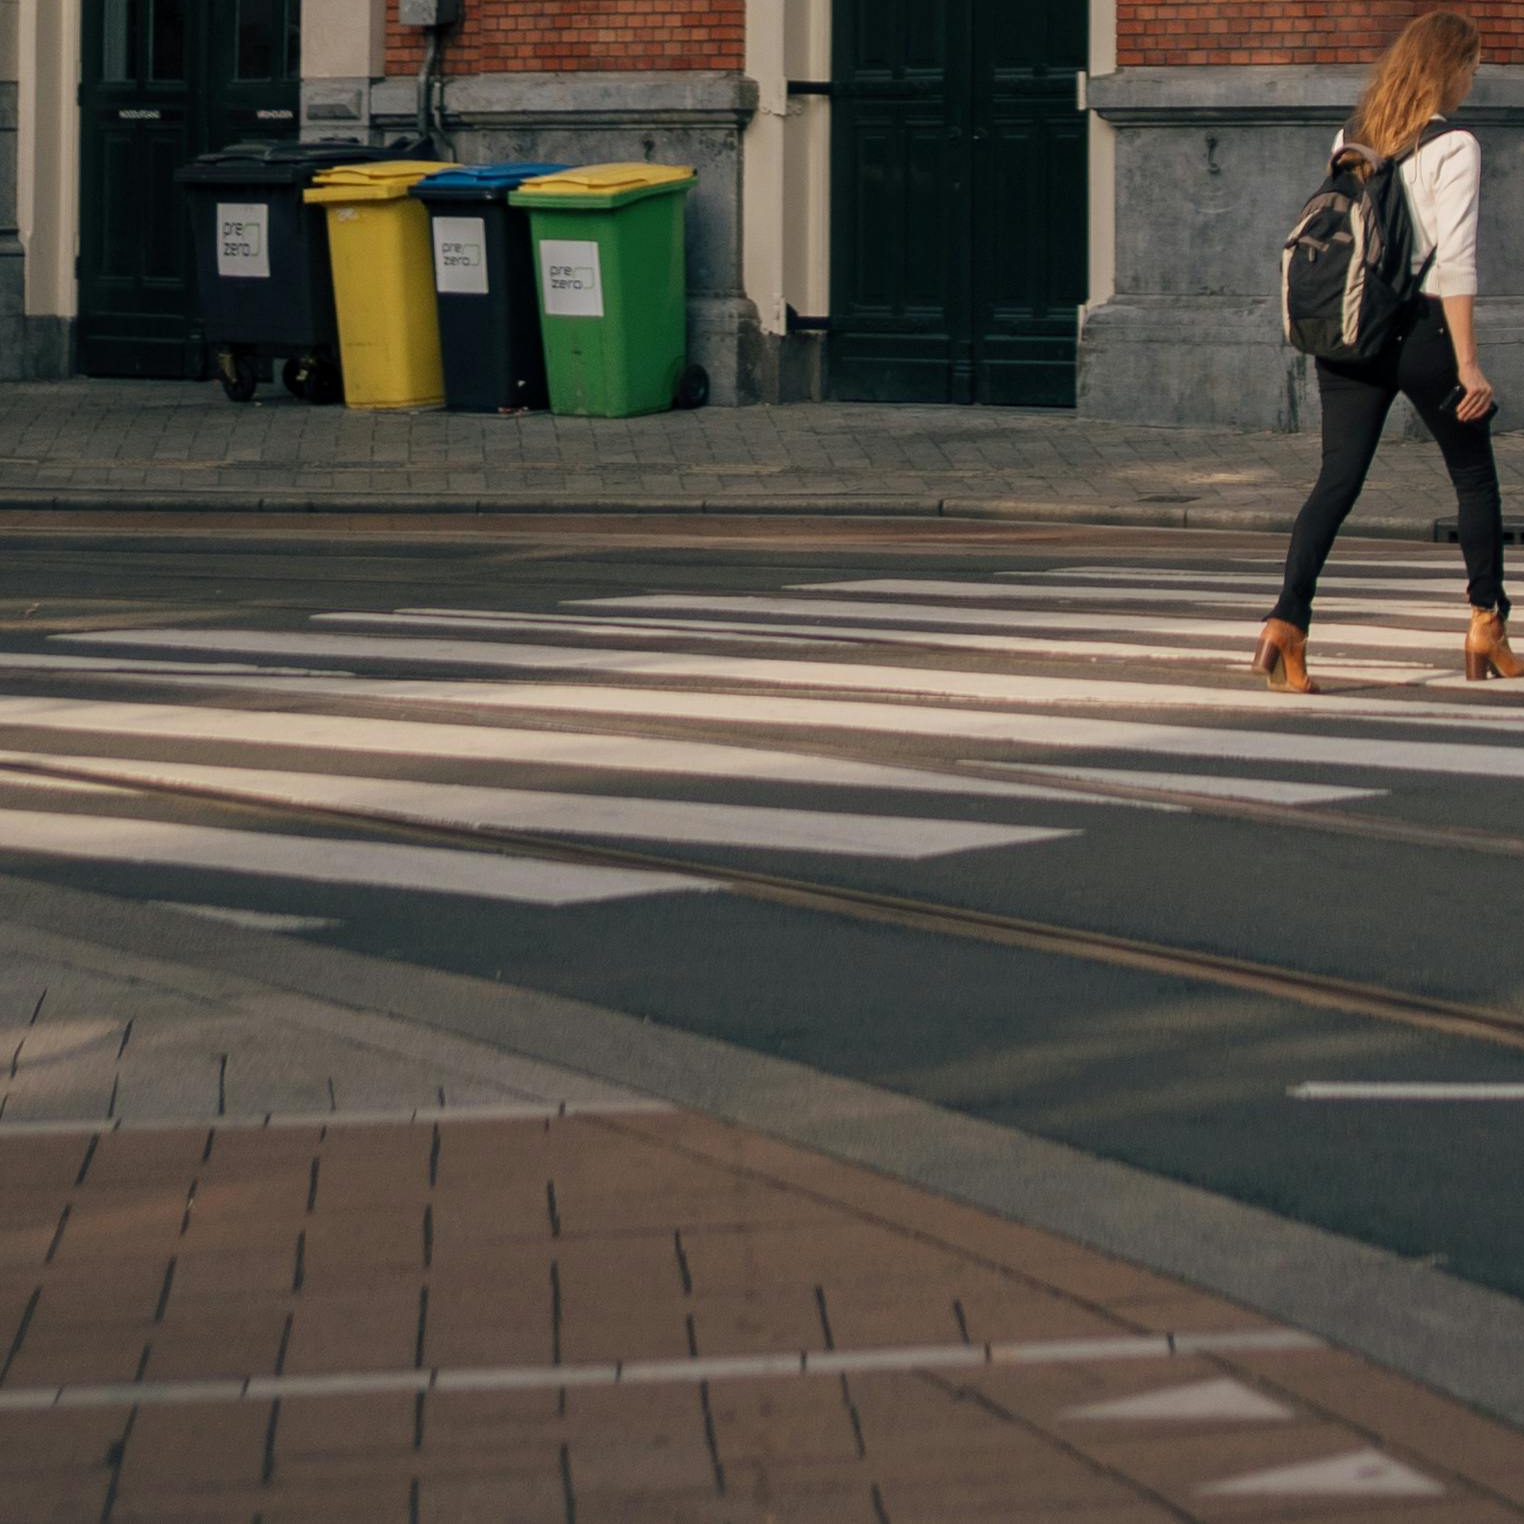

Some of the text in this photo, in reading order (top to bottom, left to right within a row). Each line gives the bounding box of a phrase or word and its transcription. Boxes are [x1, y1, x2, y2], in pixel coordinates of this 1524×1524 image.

[223, 242, 251, 257] zero
[443, 256, 471, 267] zero
[551, 279, 583, 290] zero
